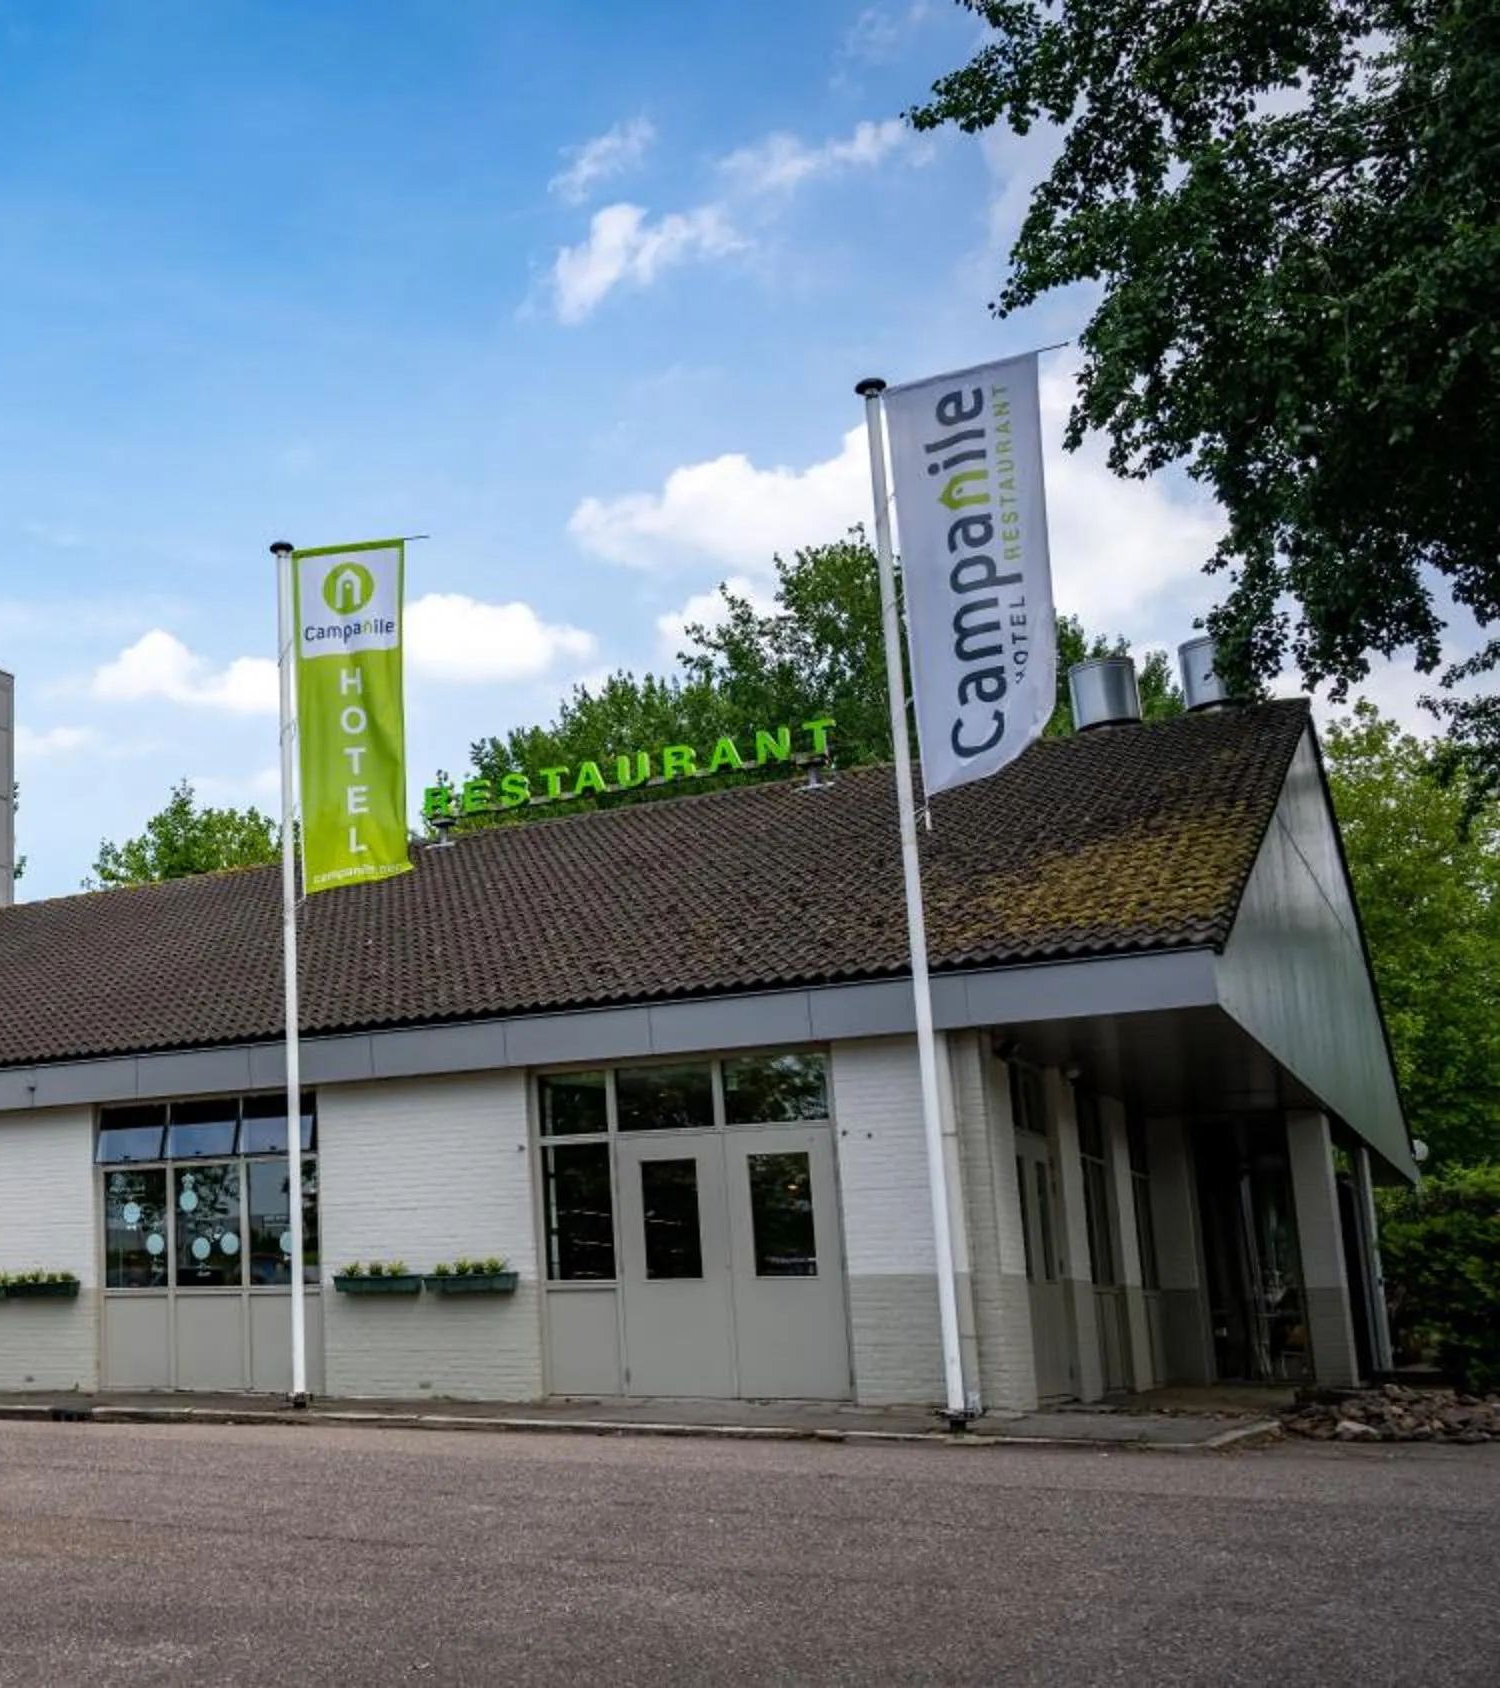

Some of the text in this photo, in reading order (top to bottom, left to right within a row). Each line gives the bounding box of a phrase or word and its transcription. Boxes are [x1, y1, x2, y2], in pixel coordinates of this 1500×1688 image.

[990, 384, 1022, 562] RESTAURANT
[305, 618, 395, 645] Campanile
[925, 387, 1023, 759] Campanile
[339, 668, 368, 855] HOTEL
[424, 718, 836, 818] RESTAURANT
